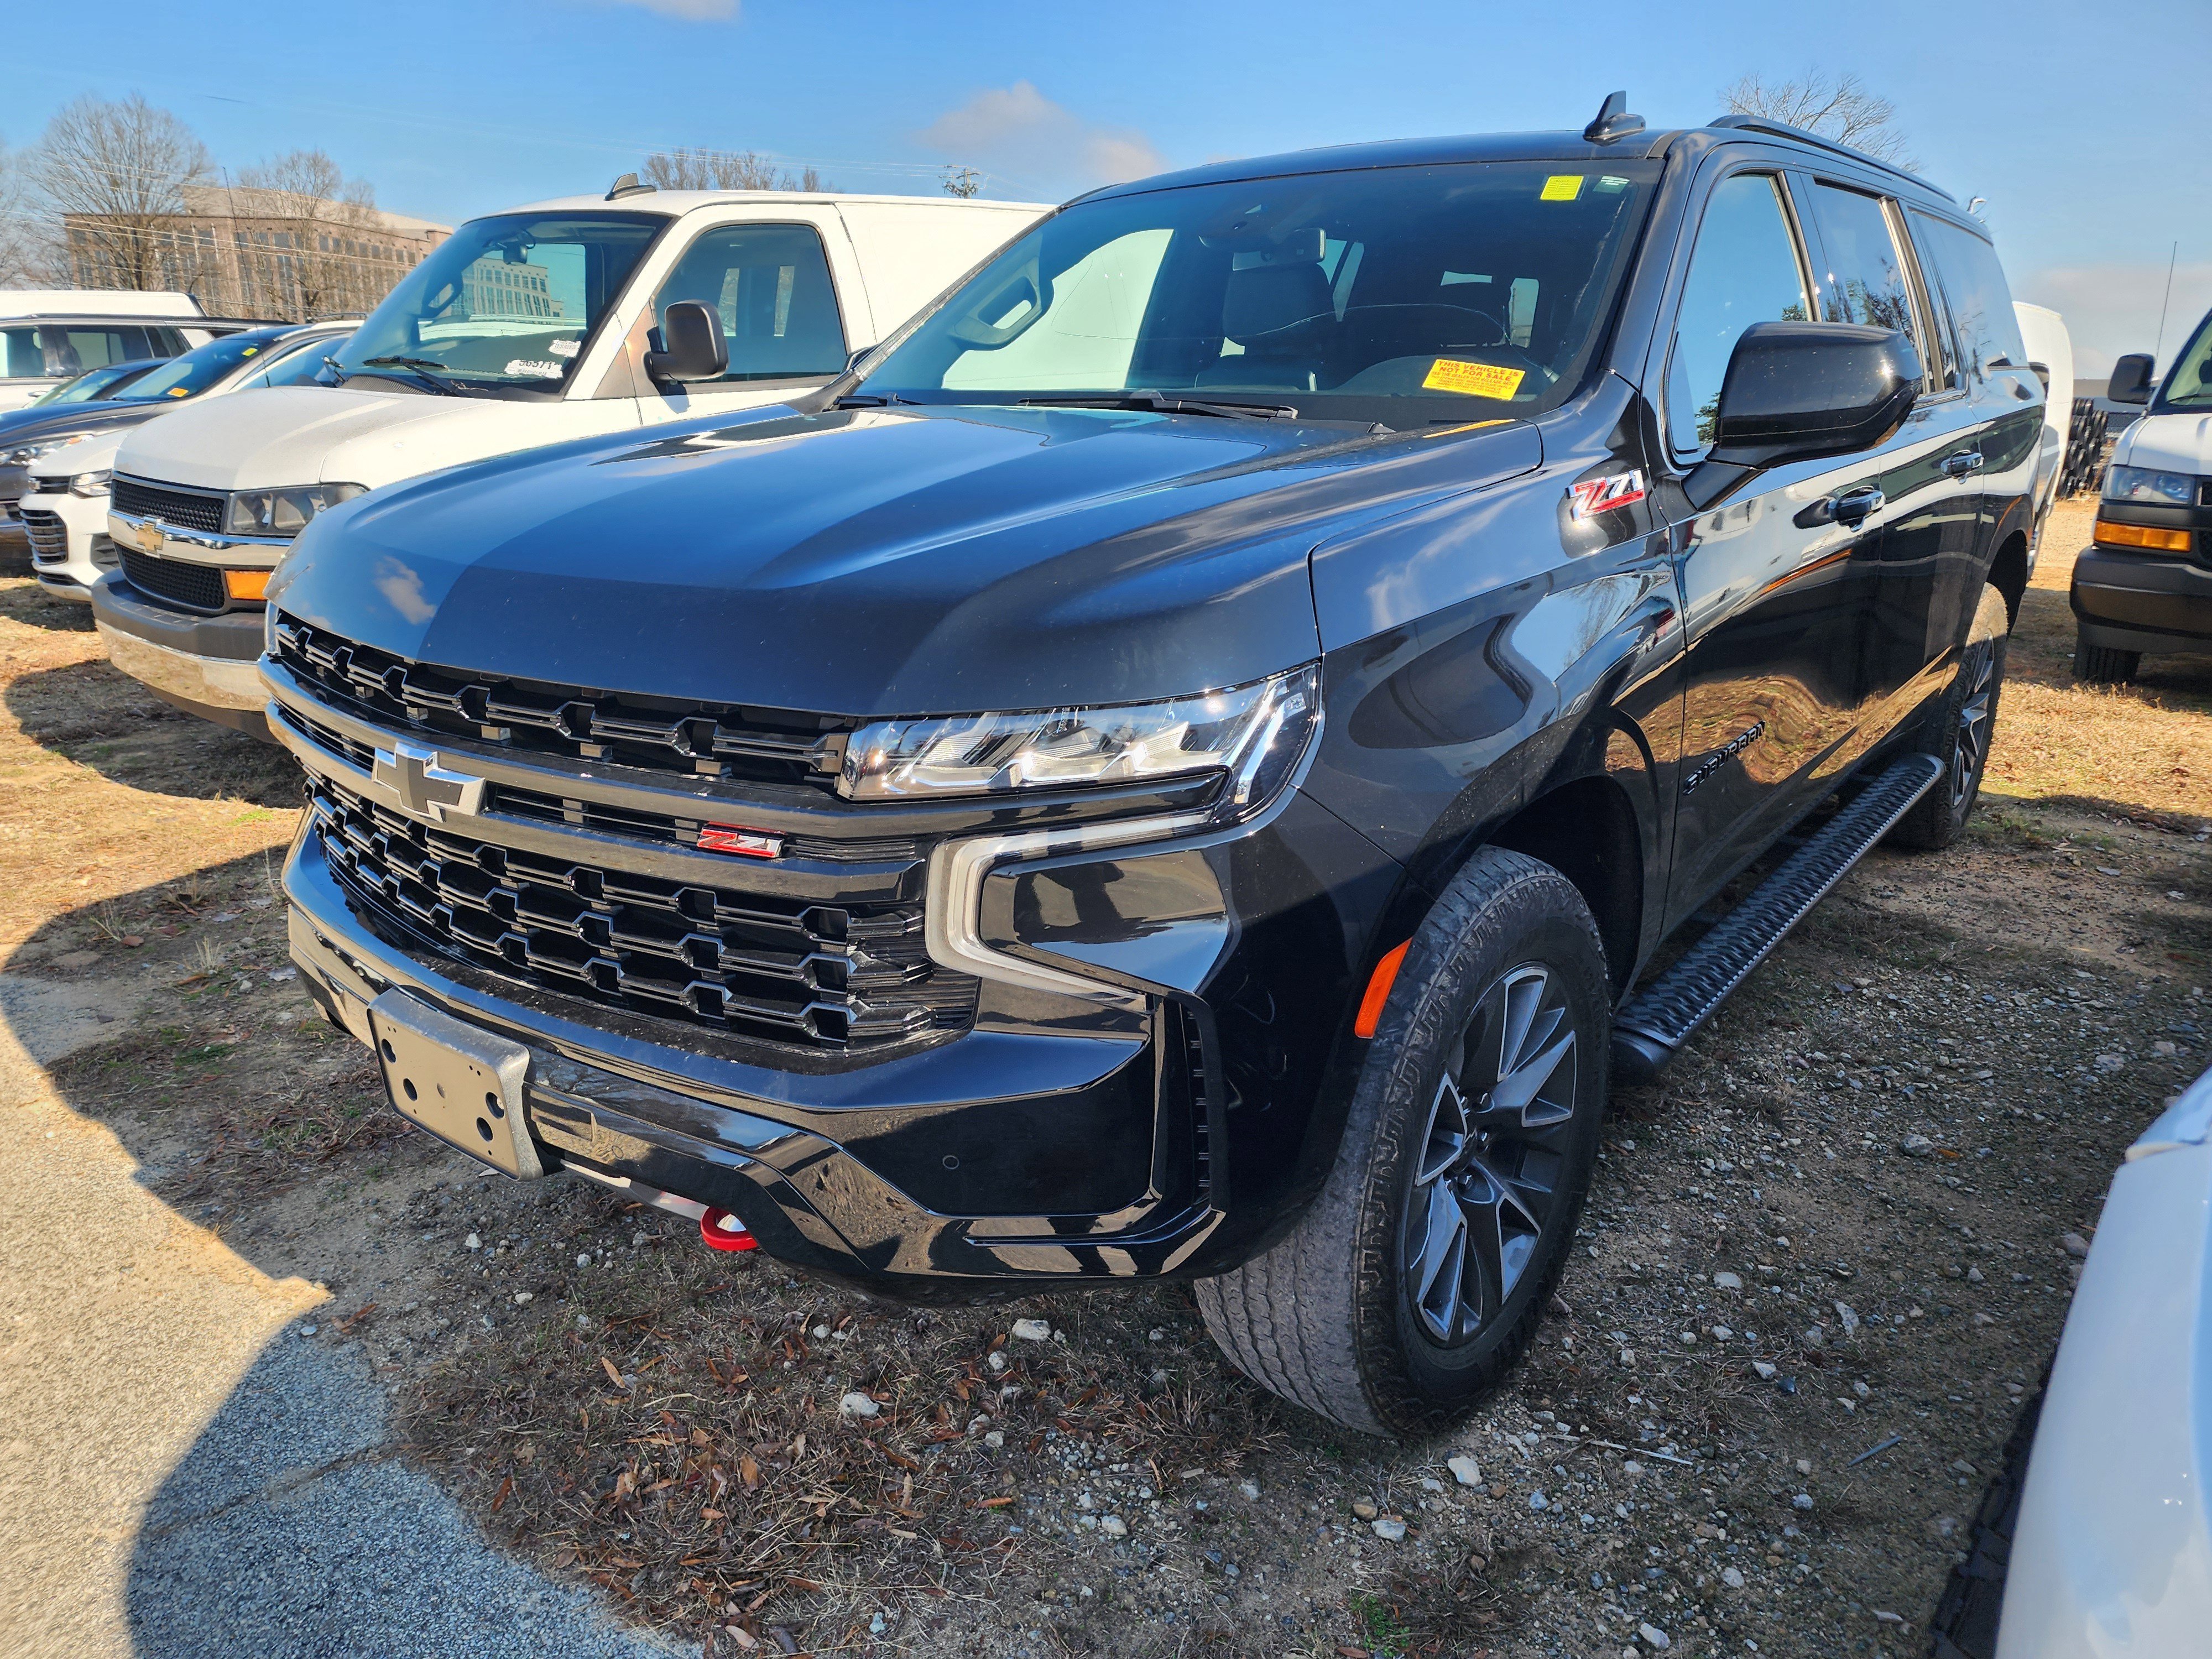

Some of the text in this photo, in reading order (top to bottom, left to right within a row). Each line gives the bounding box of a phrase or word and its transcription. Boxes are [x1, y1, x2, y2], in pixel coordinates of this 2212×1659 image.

[1464, 364, 1506, 374] VEHICLE
[1566, 469, 1645, 522] Z71
[1683, 720, 1766, 795] SUBURBAN
[696, 827, 784, 858] Z71
